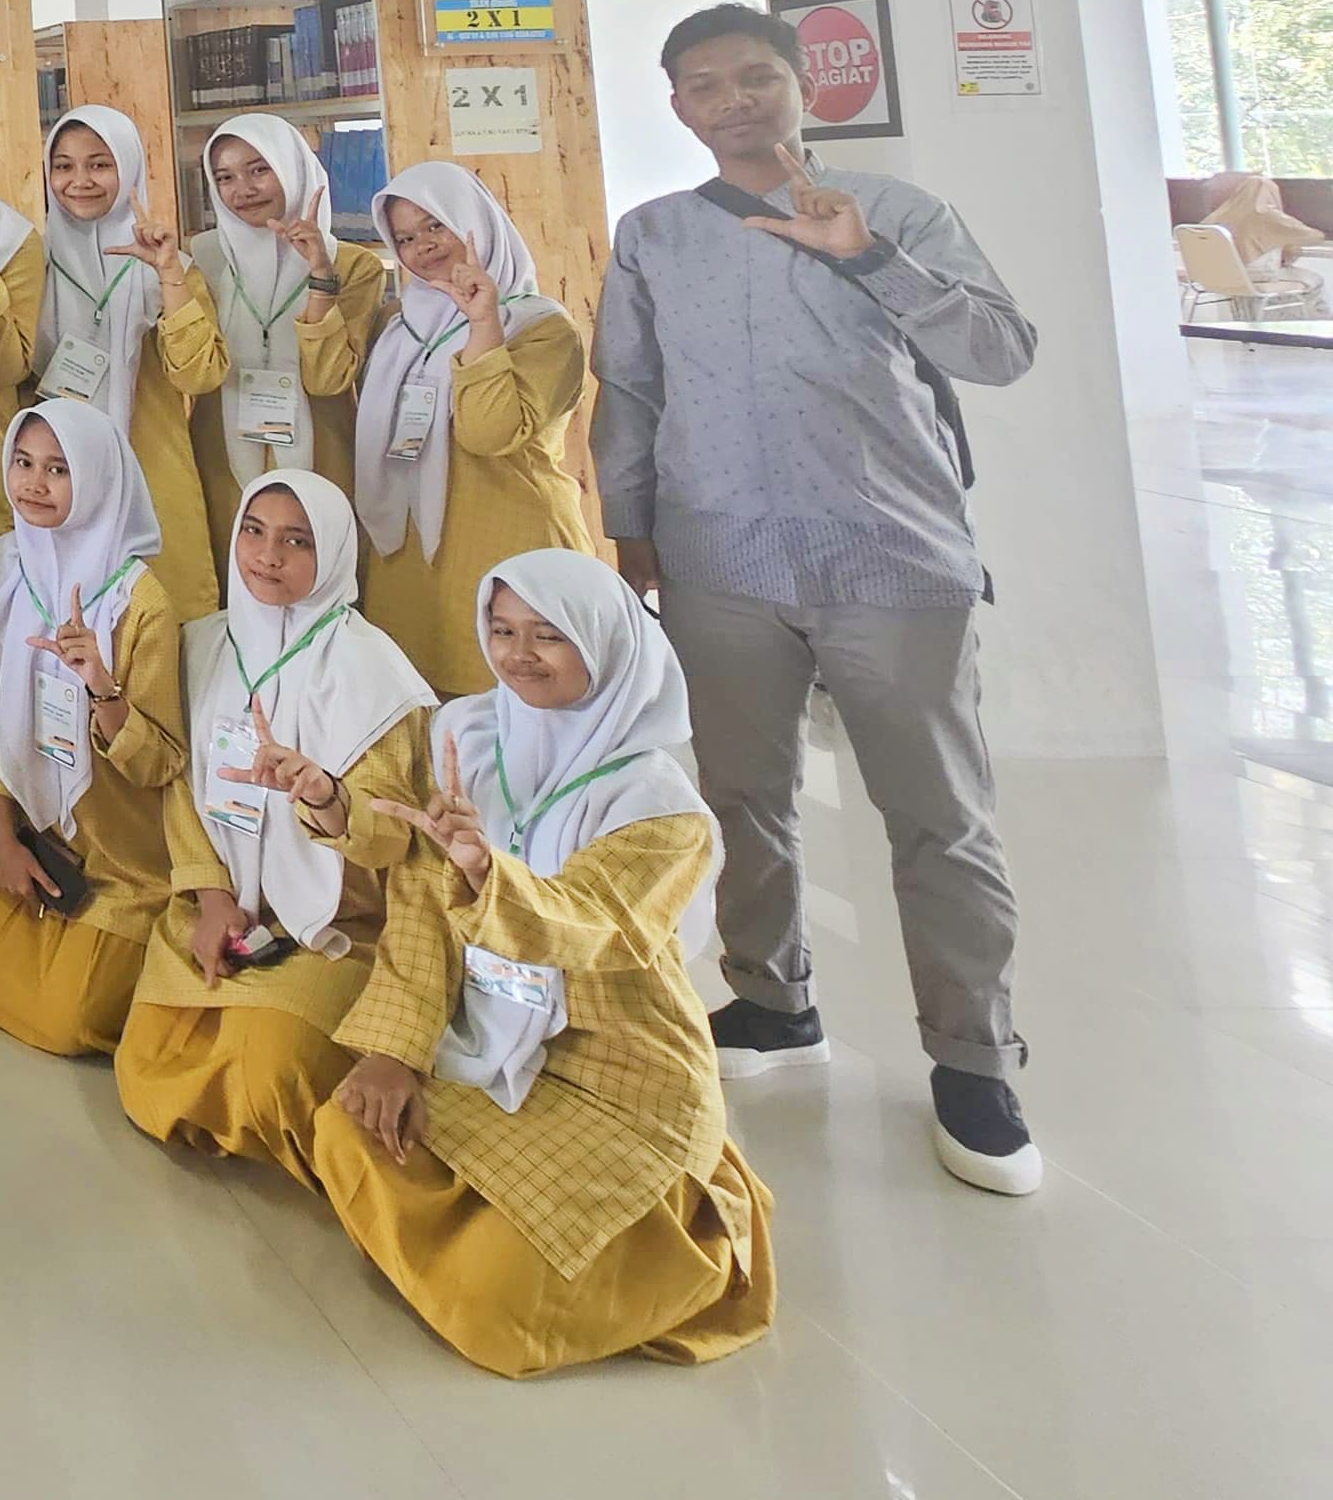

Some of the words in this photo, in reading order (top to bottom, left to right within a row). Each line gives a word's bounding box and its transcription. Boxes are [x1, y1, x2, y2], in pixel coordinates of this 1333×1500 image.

[467, 10, 480, 27] 2
[486, 10, 502, 27] X
[817, 66, 874, 87] AGIAT
[451, 86, 471, 108] 2
[480, 85, 503, 107] X
[513, 84, 528, 106] 1
